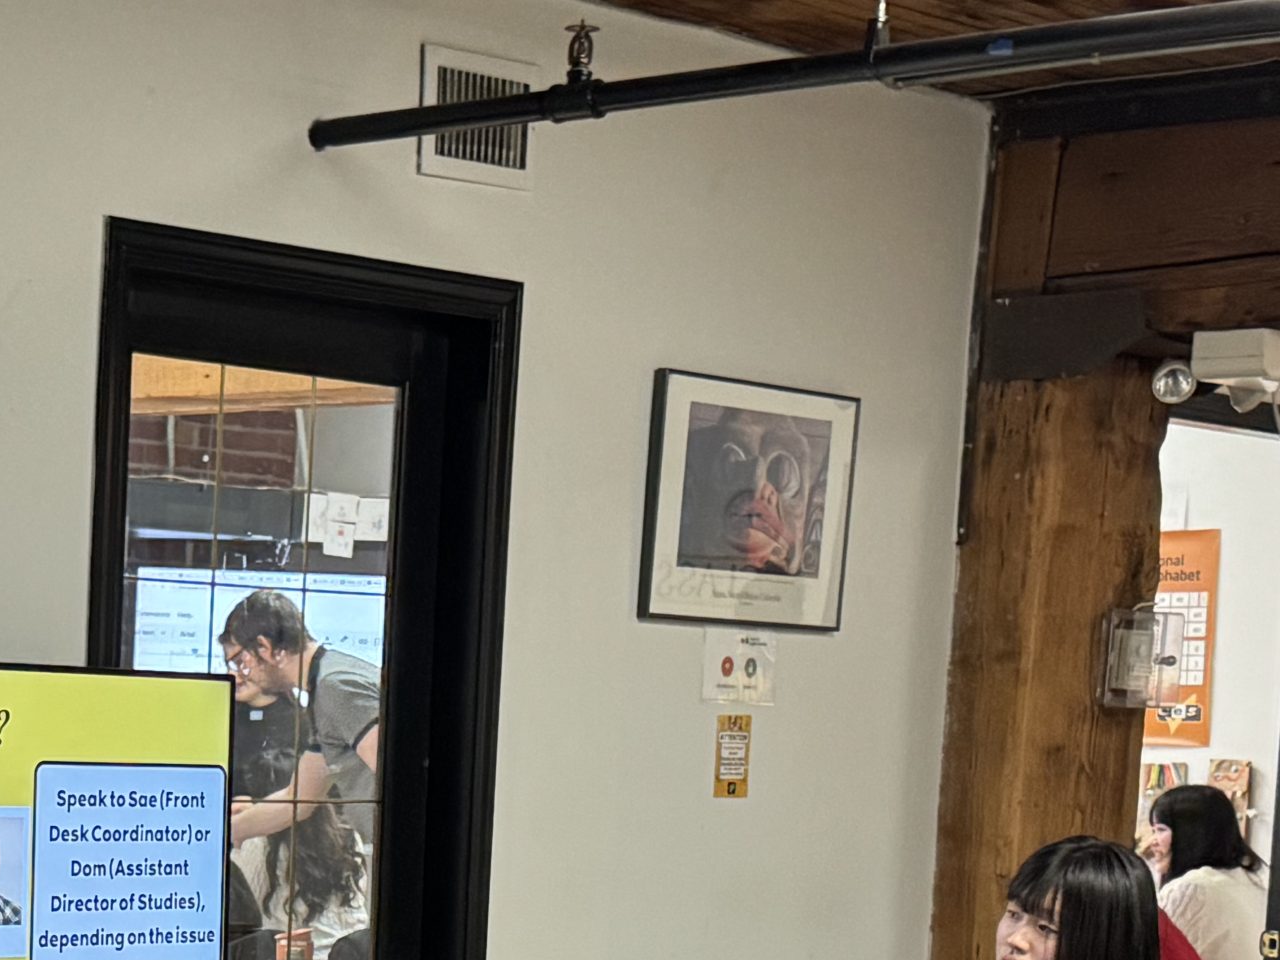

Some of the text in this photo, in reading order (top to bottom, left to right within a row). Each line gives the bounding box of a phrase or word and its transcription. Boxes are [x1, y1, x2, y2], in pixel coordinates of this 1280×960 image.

[1159, 554, 1184, 566] onal
[1159, 569, 1201, 582] phabet
[56, 789, 205, 813] Speak to Sae (Front
[49, 824, 211, 845] Desk Coordinator) or
[70, 857, 189, 880] Dom (Assistant
[50, 891, 205, 913] Director of Studies),
[38, 925, 215, 953] depending on the issue
